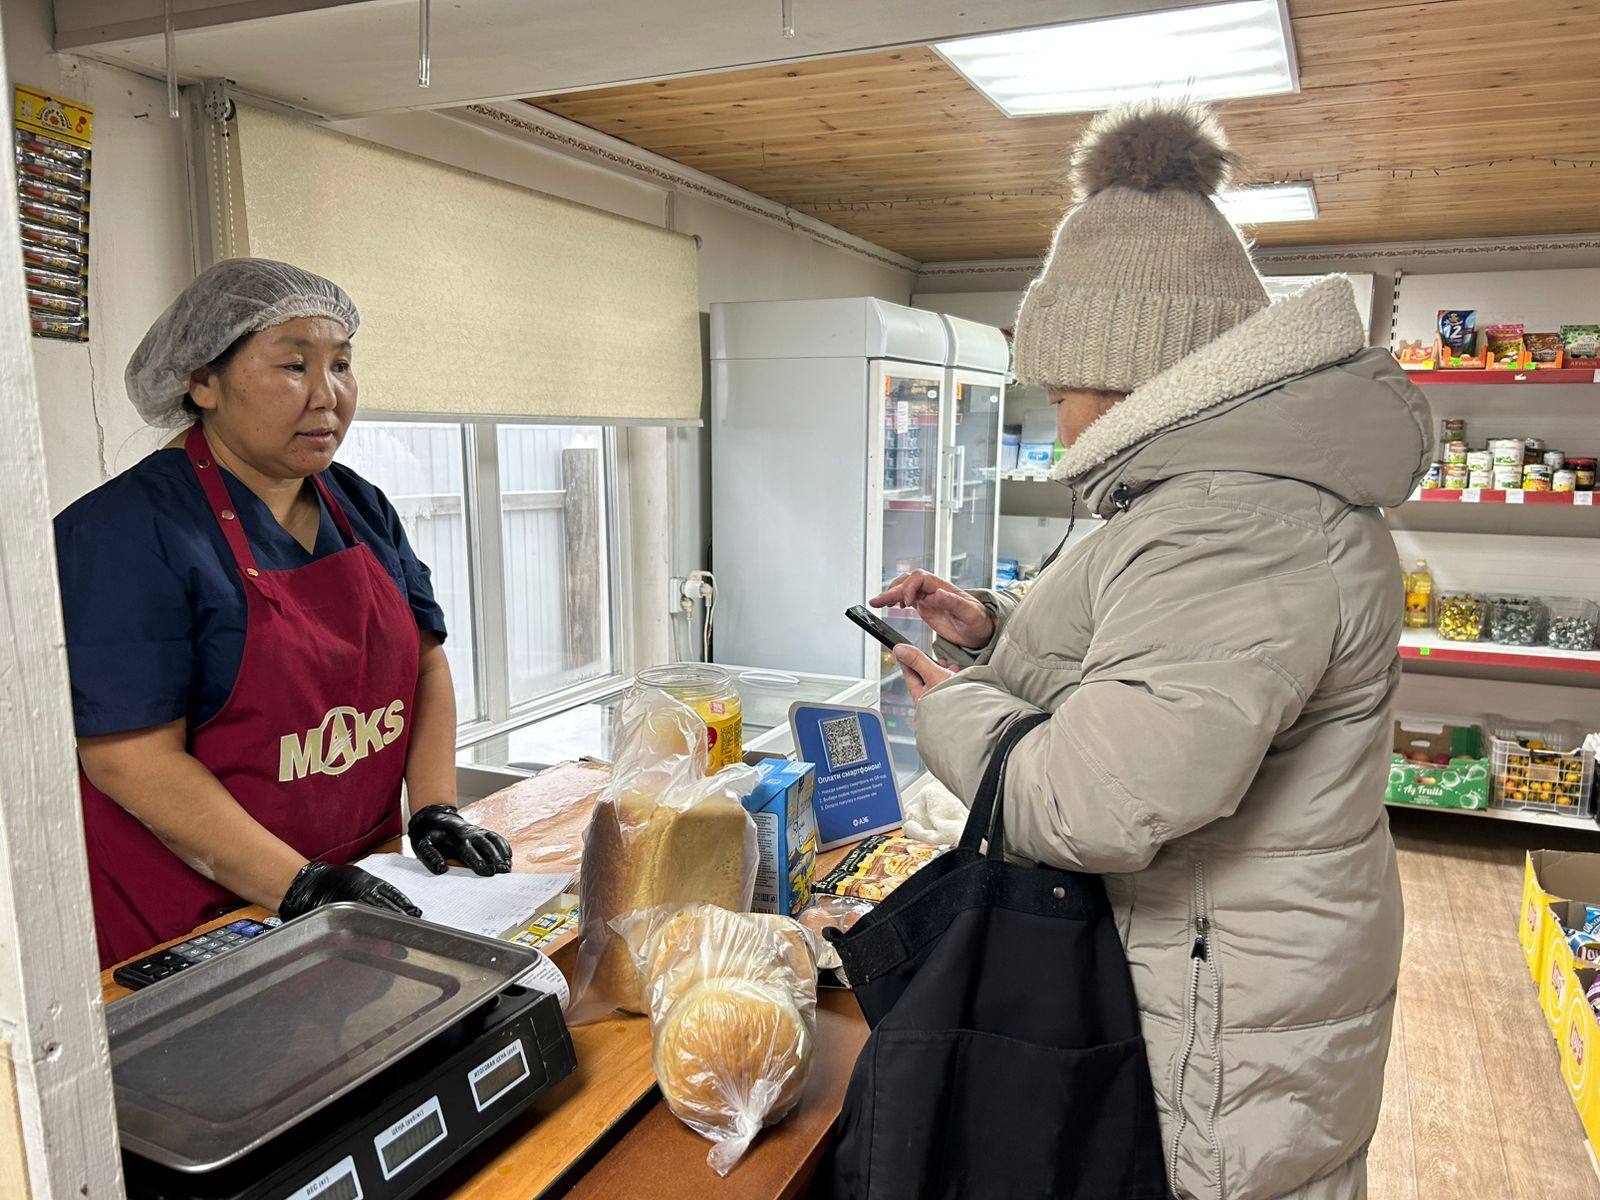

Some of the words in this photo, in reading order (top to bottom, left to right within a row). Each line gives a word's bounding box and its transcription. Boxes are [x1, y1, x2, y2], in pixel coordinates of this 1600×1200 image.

[1443, 325, 1463, 338] 12
[278, 699, 405, 782] MAKS
[817, 774, 840, 784] Оплати
[841, 762, 882, 778] смартфоном!
[1418, 785, 1443, 796] Fruits
[306, 1182, 318, 1196] ВЕС
